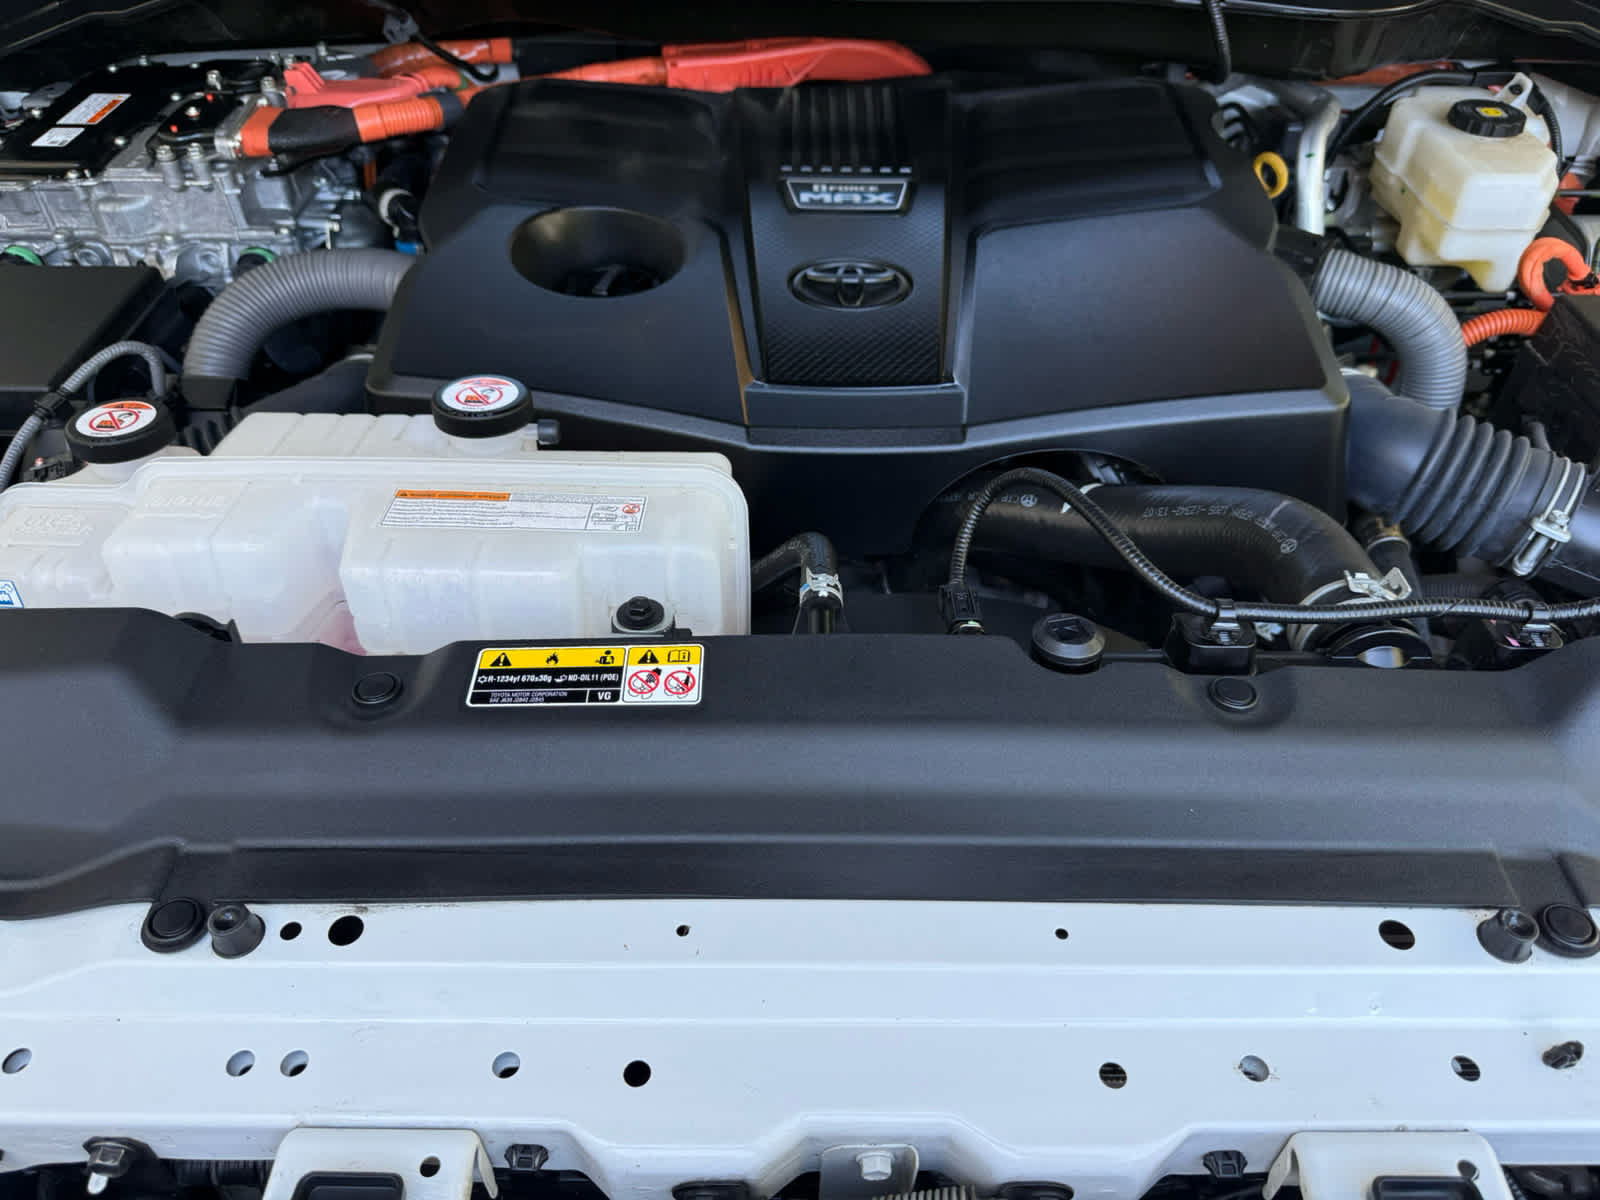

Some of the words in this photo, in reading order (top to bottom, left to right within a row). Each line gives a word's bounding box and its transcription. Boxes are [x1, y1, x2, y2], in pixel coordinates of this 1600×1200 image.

[799, 191, 896, 204] MAX
[487, 674, 520, 684] R-1234yf
[600, 673, 620, 682] (POE)
[597, 691, 612, 701] VG
